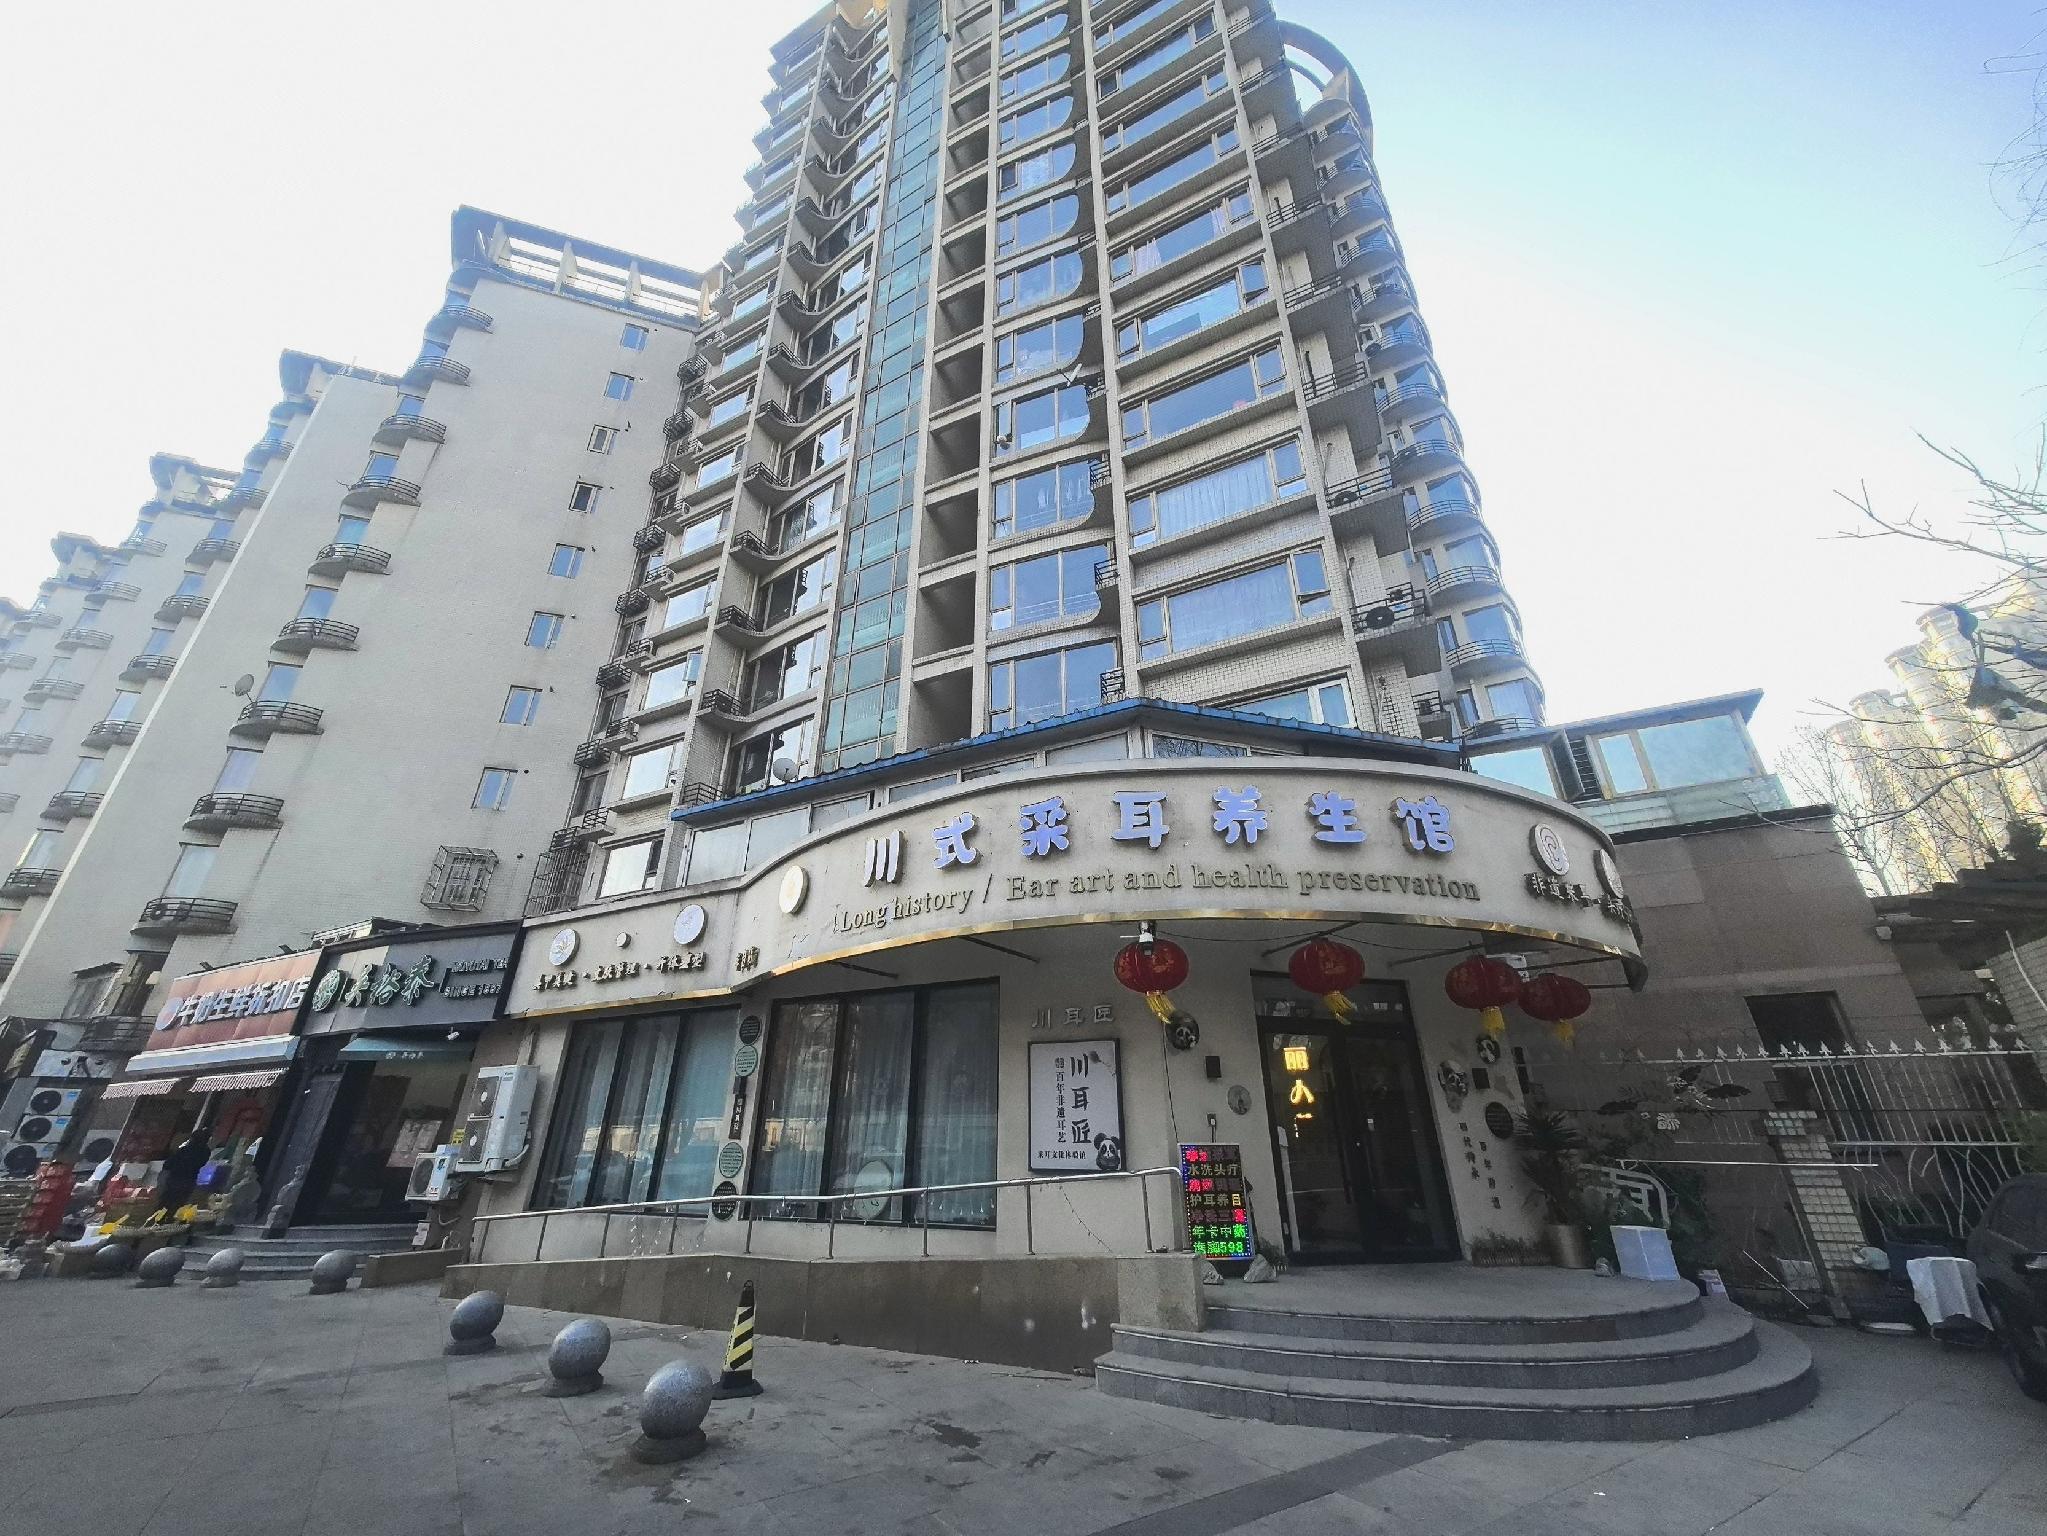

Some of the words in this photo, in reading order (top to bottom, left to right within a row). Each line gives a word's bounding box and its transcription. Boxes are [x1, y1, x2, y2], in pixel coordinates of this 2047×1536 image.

[863, 784, 1455, 888] 川式采耳养生馆
[840, 904, 888, 933] Long
[891, 888, 974, 920] history
[1006, 875, 1060, 901] Ear
[1070, 869, 1115, 893] art
[1123, 864, 1181, 891] and
[1190, 864, 1288, 889] health
[1297, 869, 1481, 901] preservation
[344, 954, 435, 1007] 吴裕泰
[1031, 1004, 1115, 1028] 川耳匠
[1070, 1053, 1092, 1144] 川耳匠
